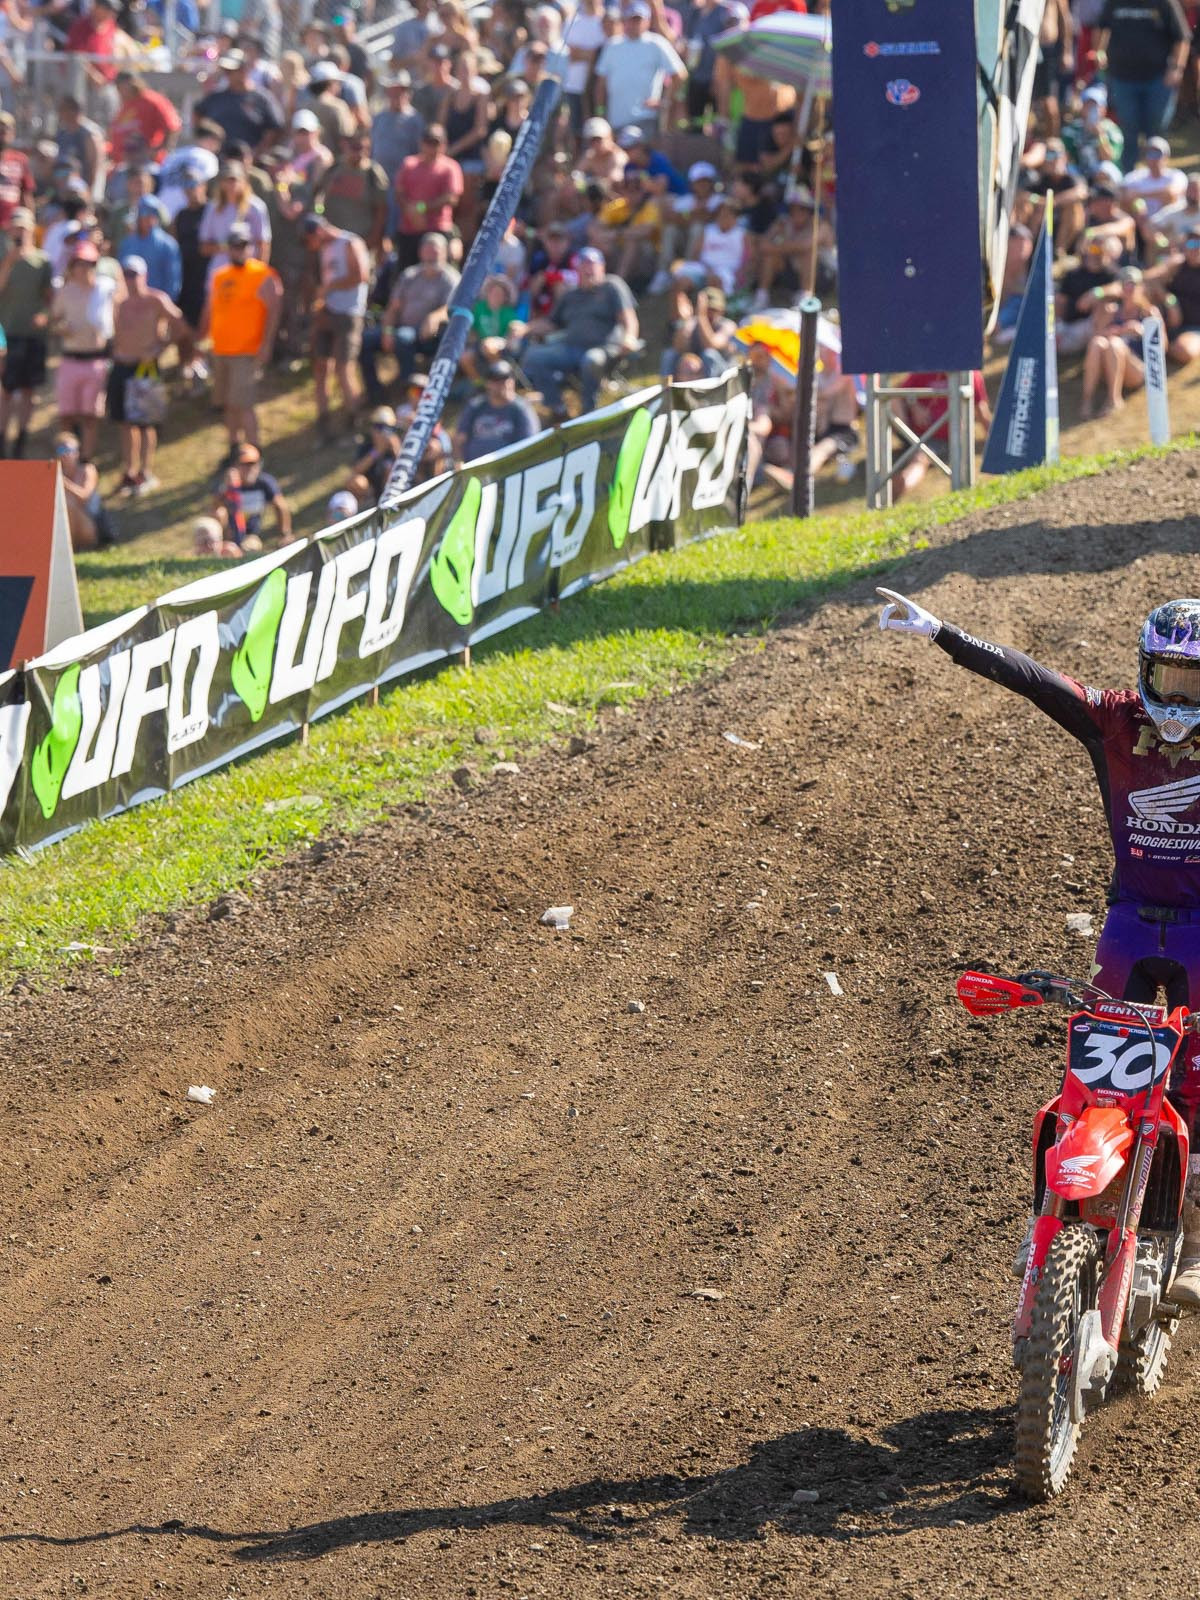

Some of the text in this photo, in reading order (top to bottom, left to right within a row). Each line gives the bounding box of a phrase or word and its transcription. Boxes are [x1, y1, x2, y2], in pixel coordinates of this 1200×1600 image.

[629, 392, 751, 533] UFO
[471, 441, 600, 608] UFO
[269, 517, 426, 704] UFO
[62, 610, 220, 799] UFO
[965, 975, 993, 985] HONDA
[1071, 1033, 1171, 1090] 30
[1097, 1088, 1125, 1098] HONDA
[1058, 1168, 1097, 1179] HONDA
